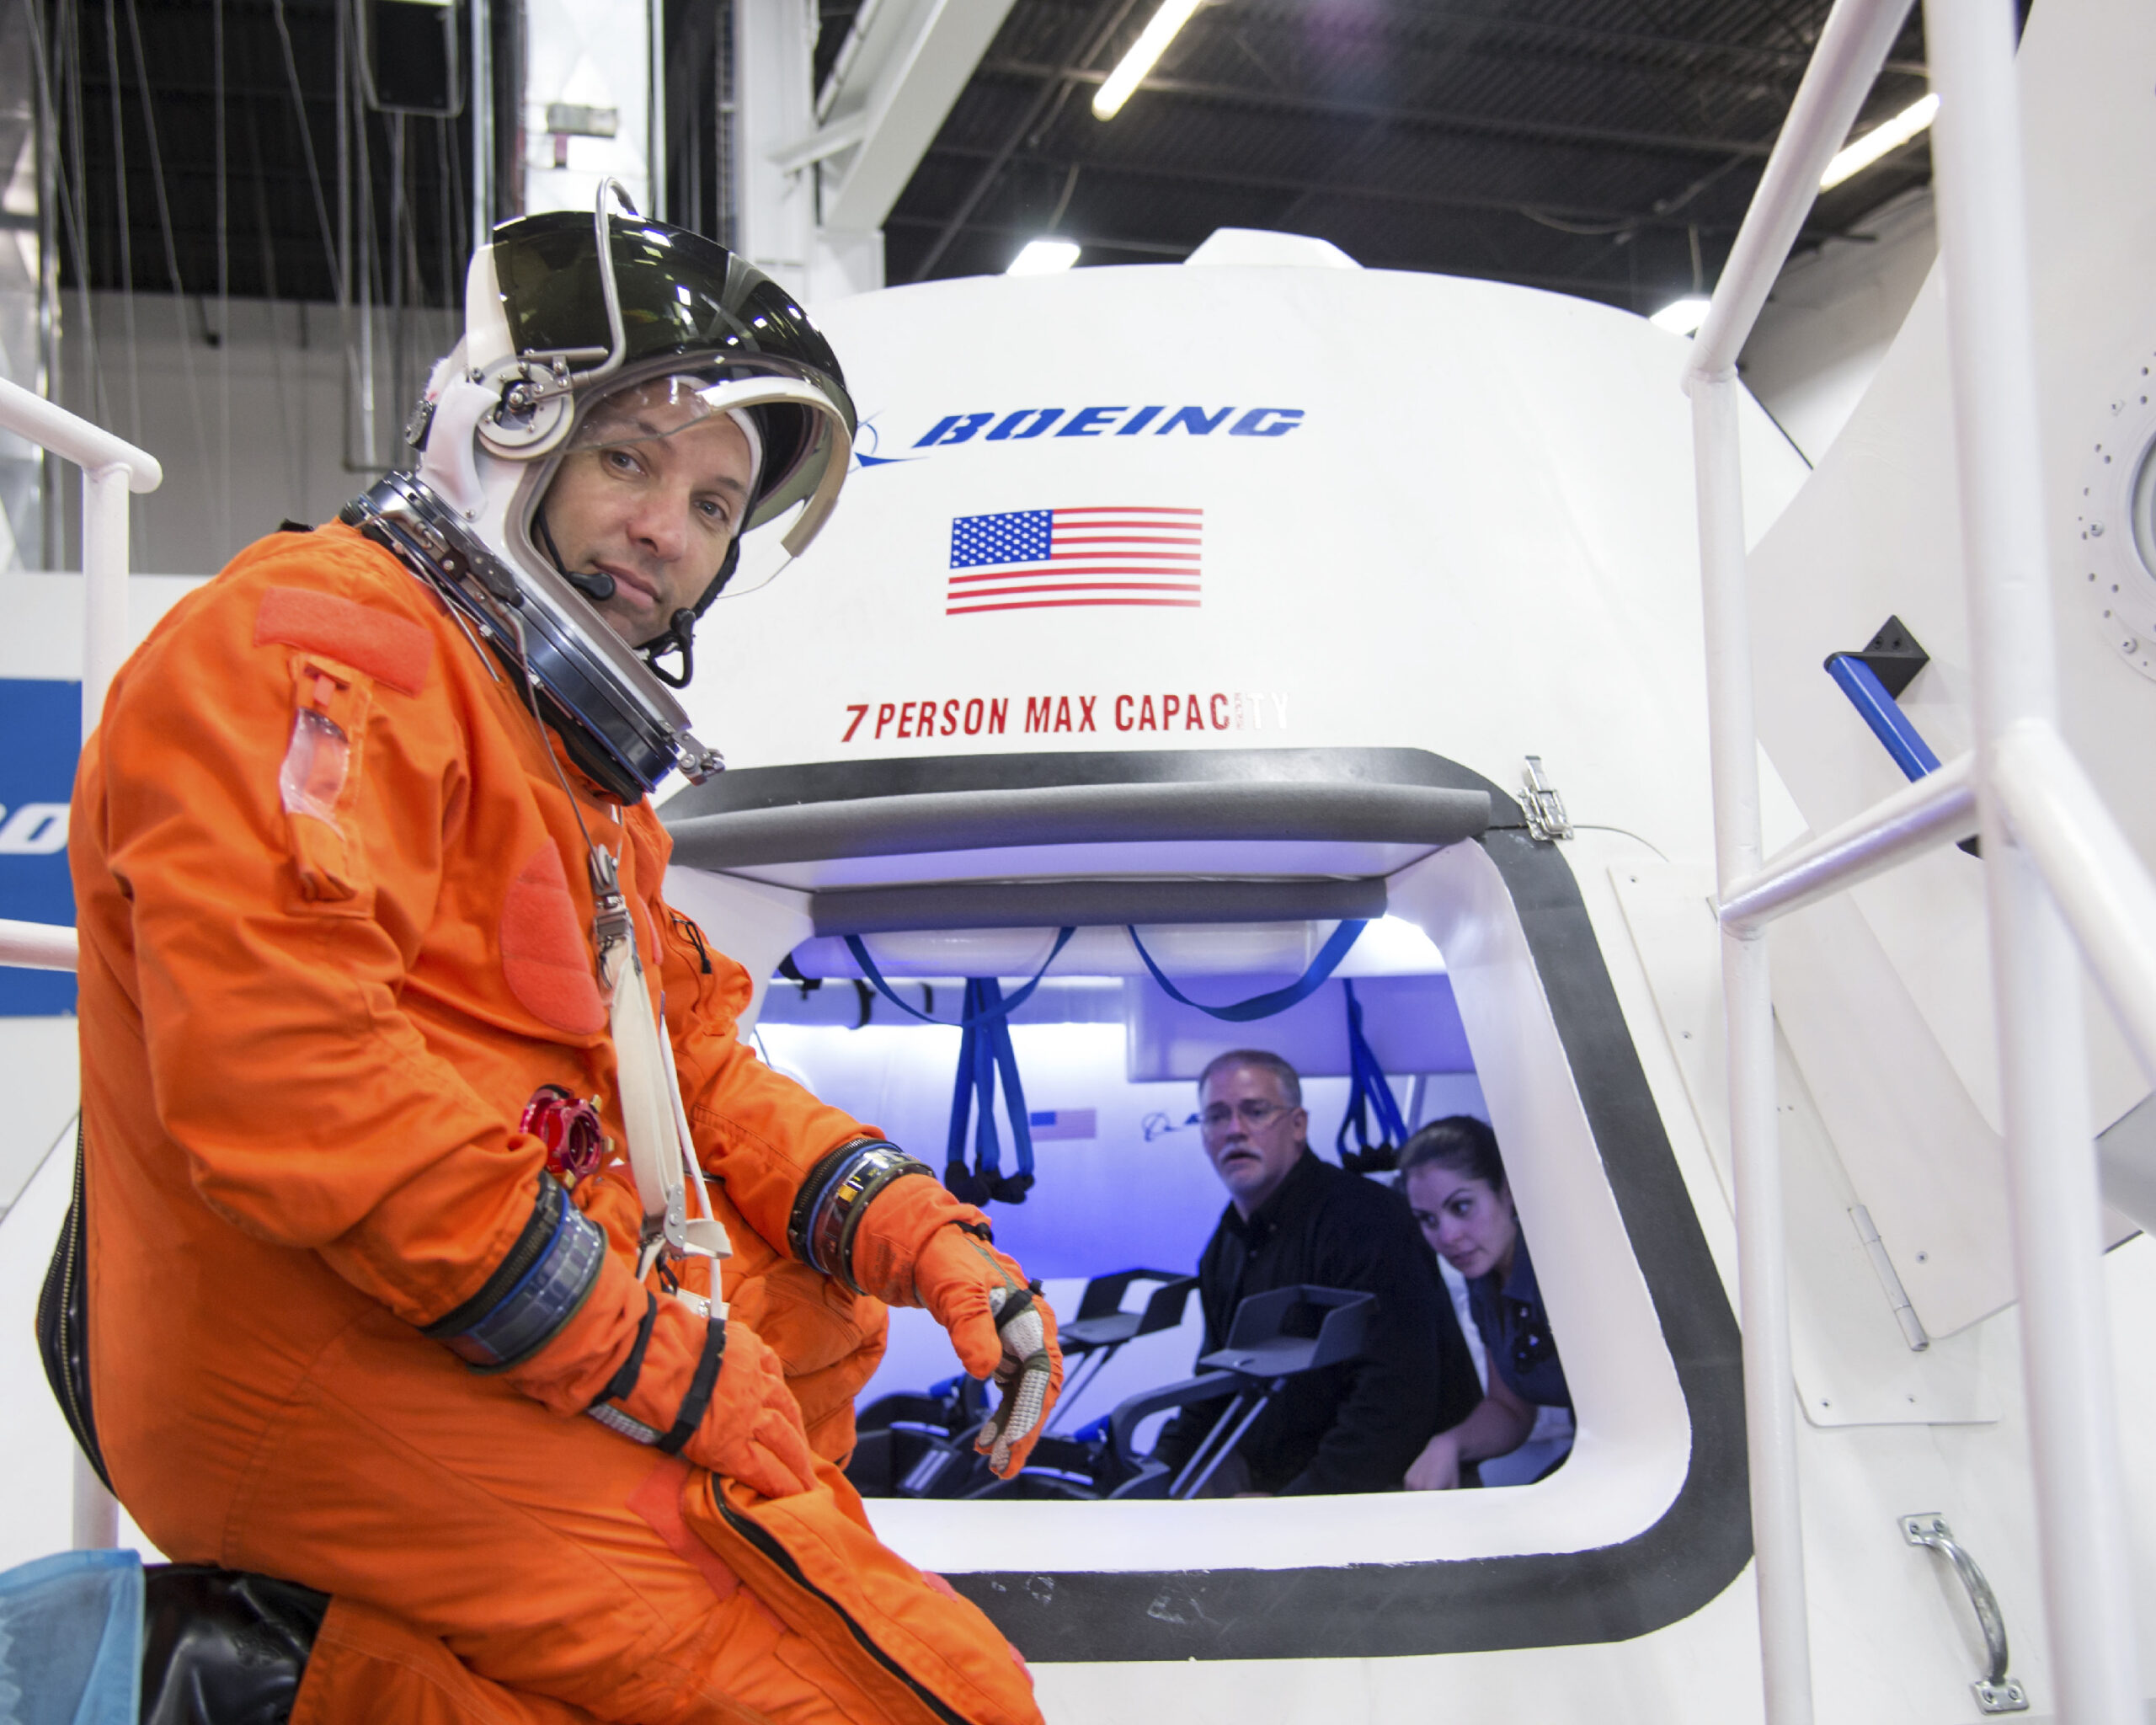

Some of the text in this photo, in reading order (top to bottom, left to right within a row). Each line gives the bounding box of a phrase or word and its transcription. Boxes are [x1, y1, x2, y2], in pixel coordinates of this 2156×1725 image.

[911, 405, 1305, 448] BOEING
[841, 704, 869, 743] 7
[874, 697, 1009, 740] PERSON
[1024, 695, 1097, 734] MAX
